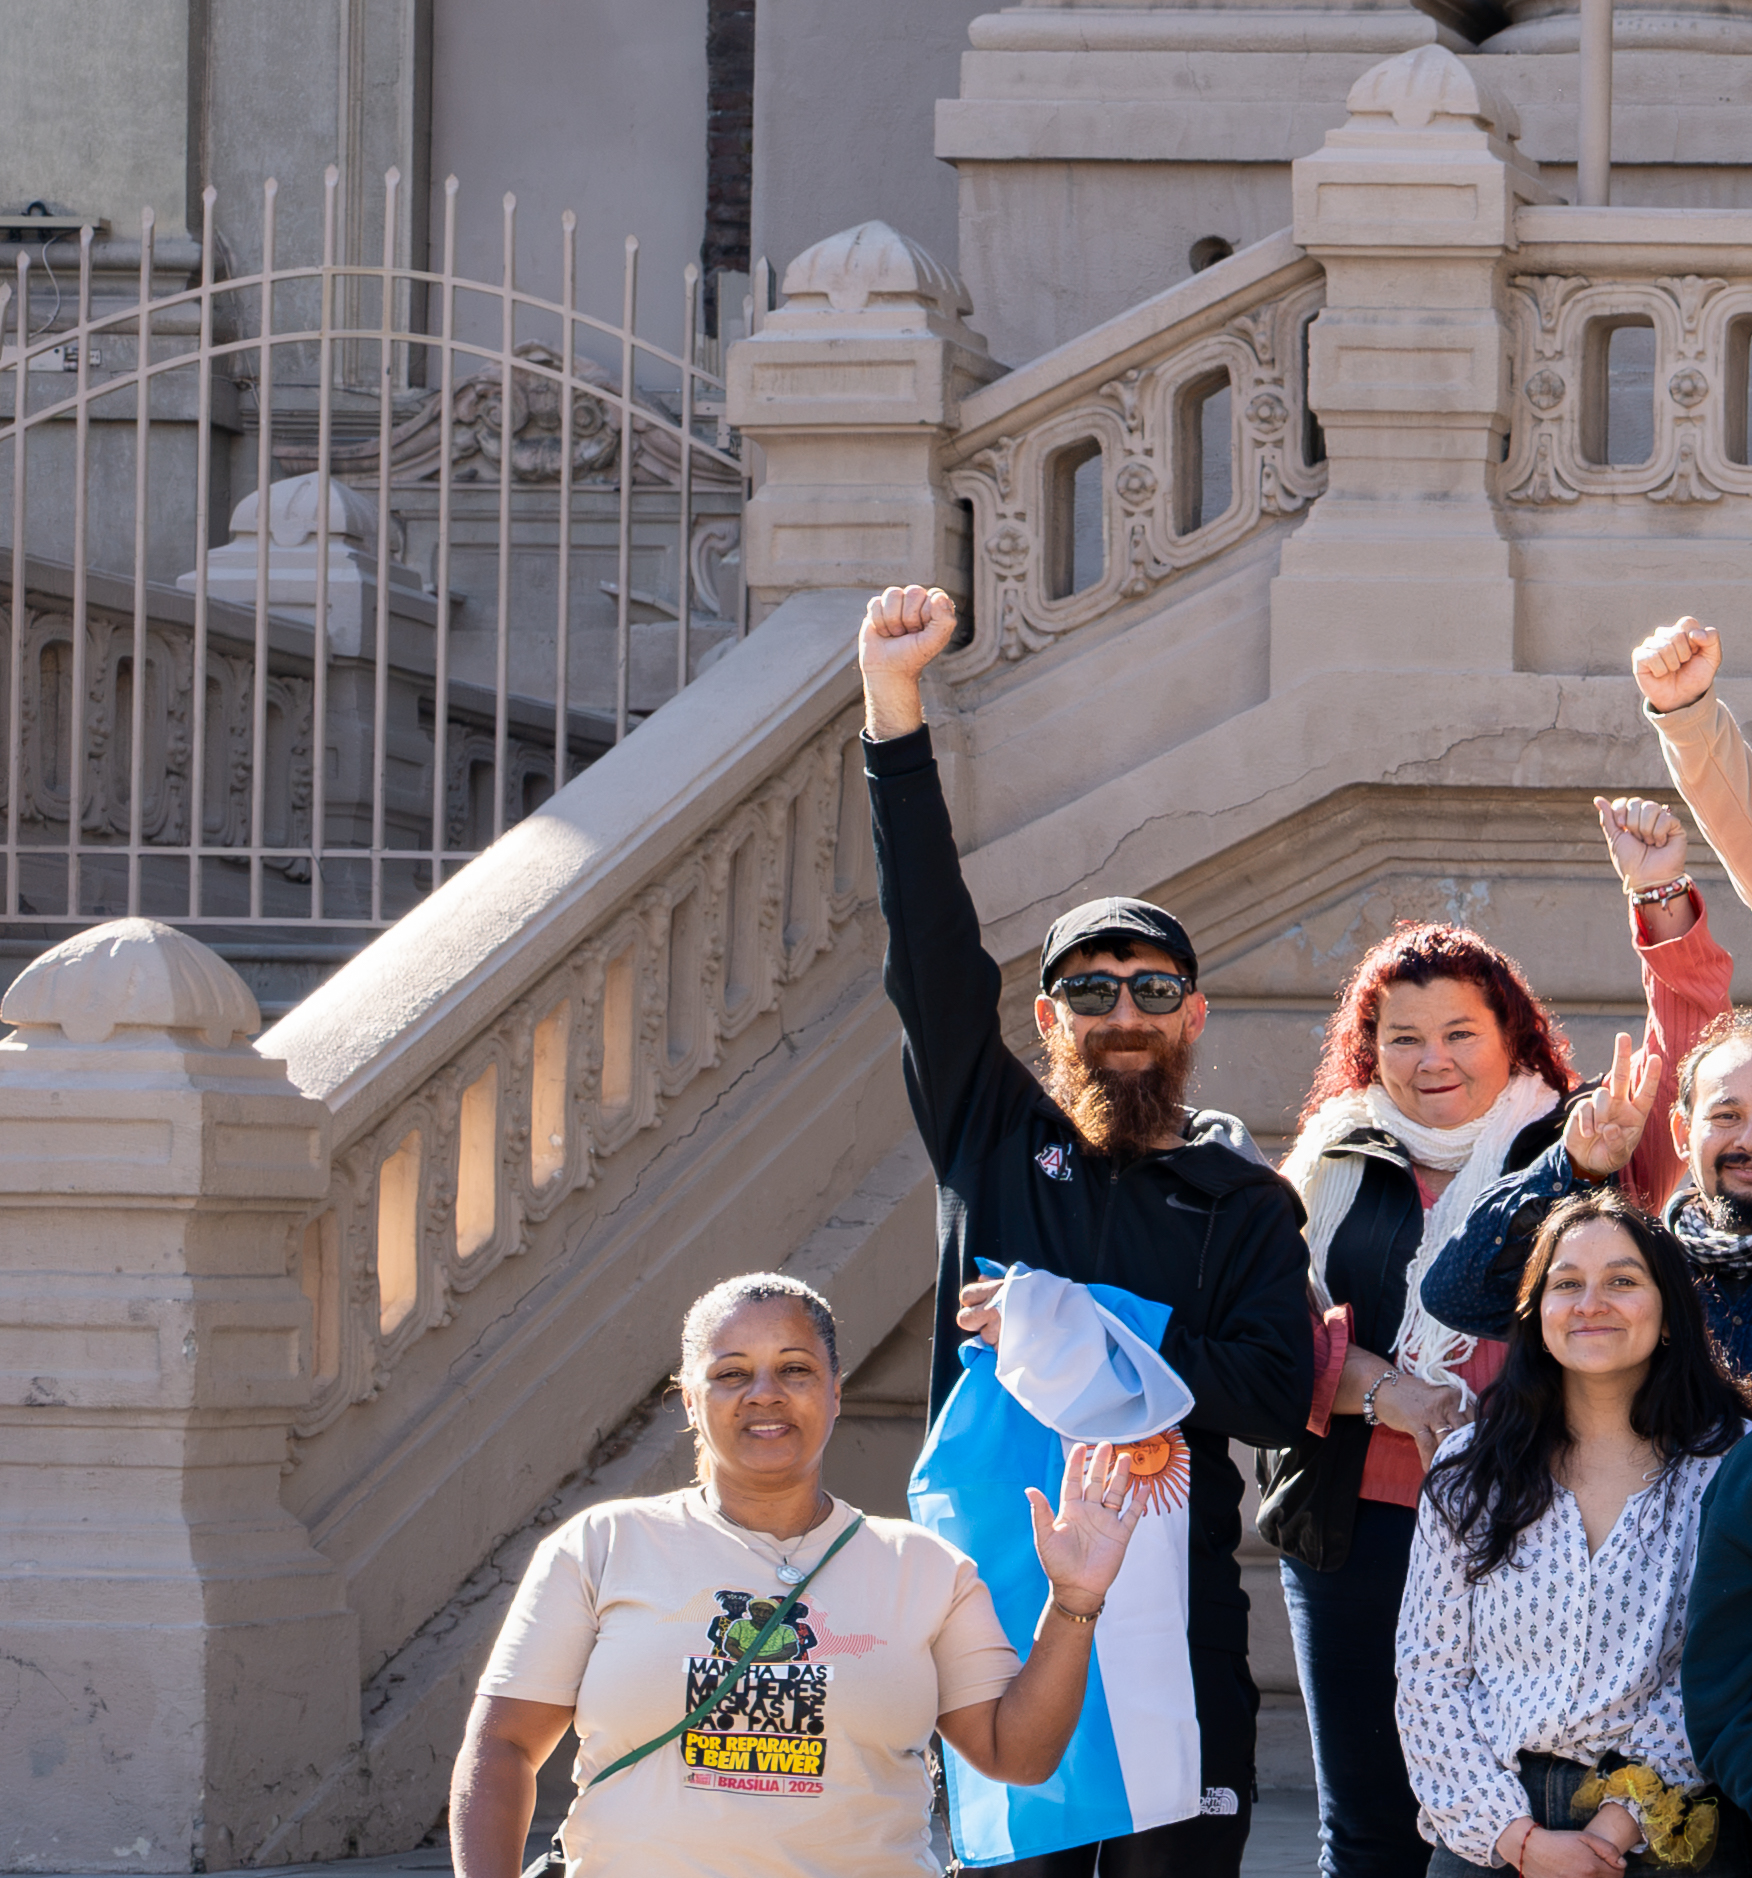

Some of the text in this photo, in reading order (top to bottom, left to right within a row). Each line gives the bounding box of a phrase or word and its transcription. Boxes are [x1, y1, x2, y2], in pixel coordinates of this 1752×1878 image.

[788, 1664, 828, 1681] DAS
[686, 1733, 721, 1751] POR
[685, 1746, 820, 1775] E BEM VIVER
[788, 1781, 824, 1794] 2025
[1199, 1797, 1221, 1806] ORTH
